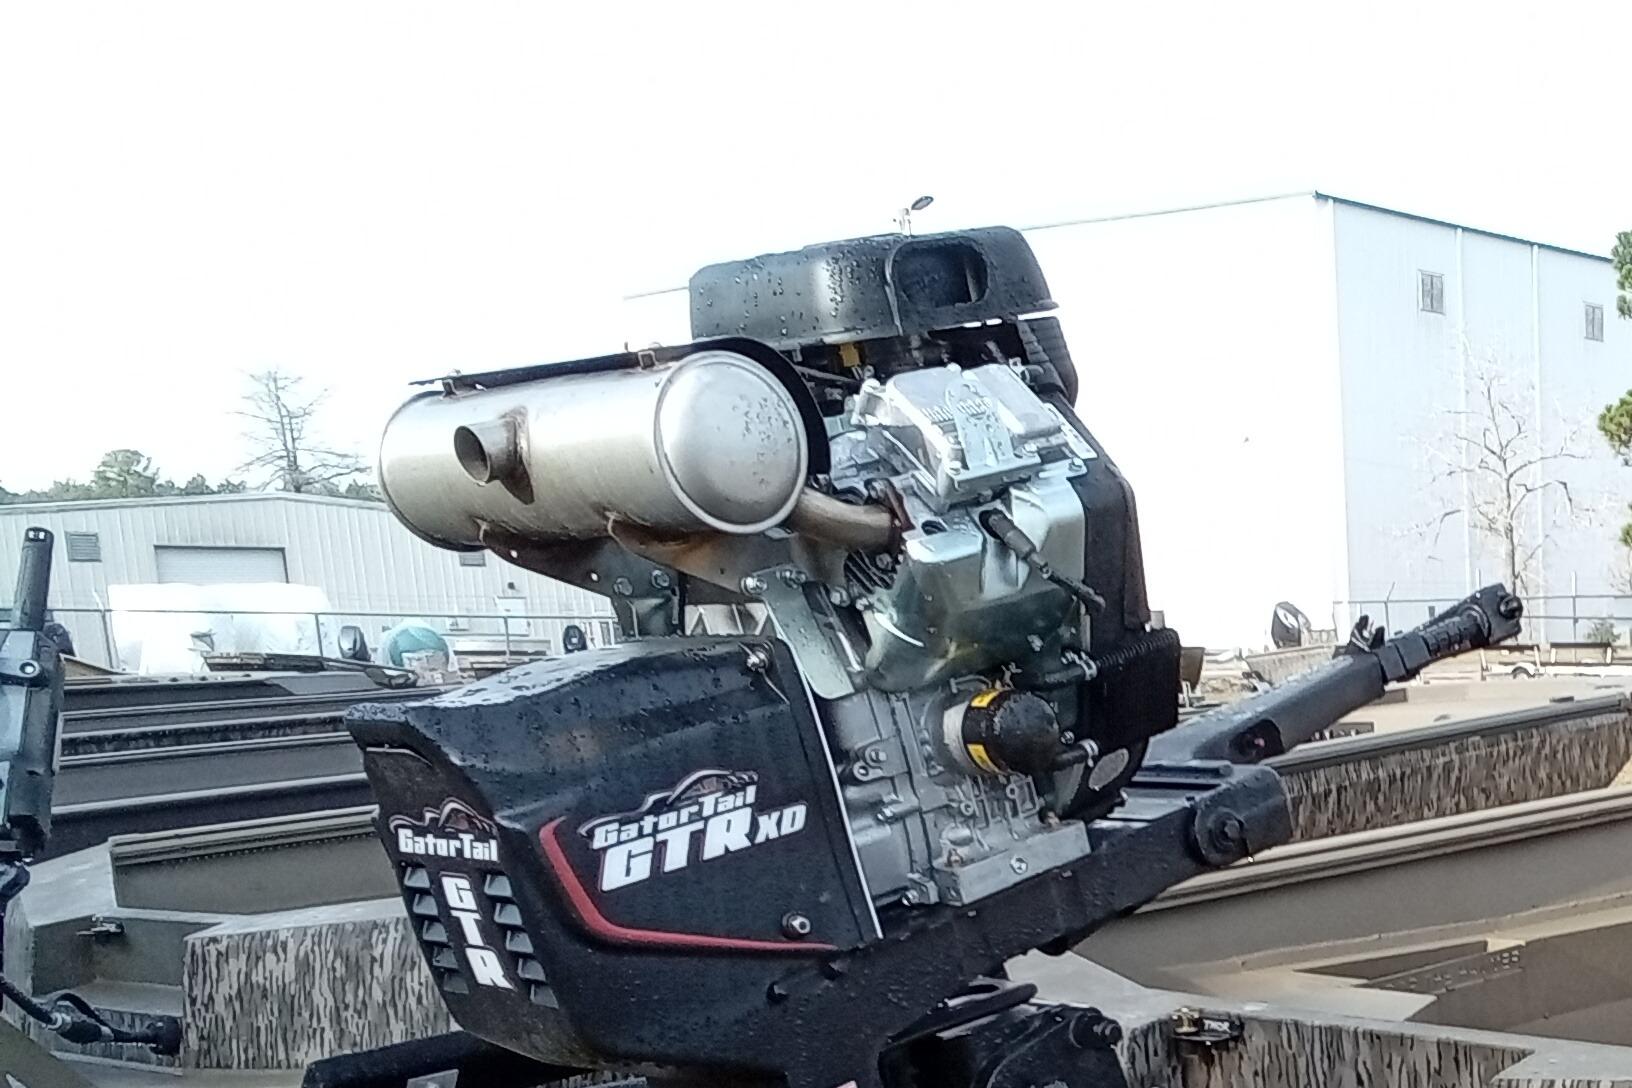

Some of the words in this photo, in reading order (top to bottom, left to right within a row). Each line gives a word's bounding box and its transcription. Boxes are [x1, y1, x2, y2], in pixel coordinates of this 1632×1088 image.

[397, 827, 499, 862] GatorTail
[591, 784, 757, 850] GatorTail
[600, 806, 753, 892] GTR
[753, 803, 808, 845] XD
[441, 875, 516, 990] GTR
